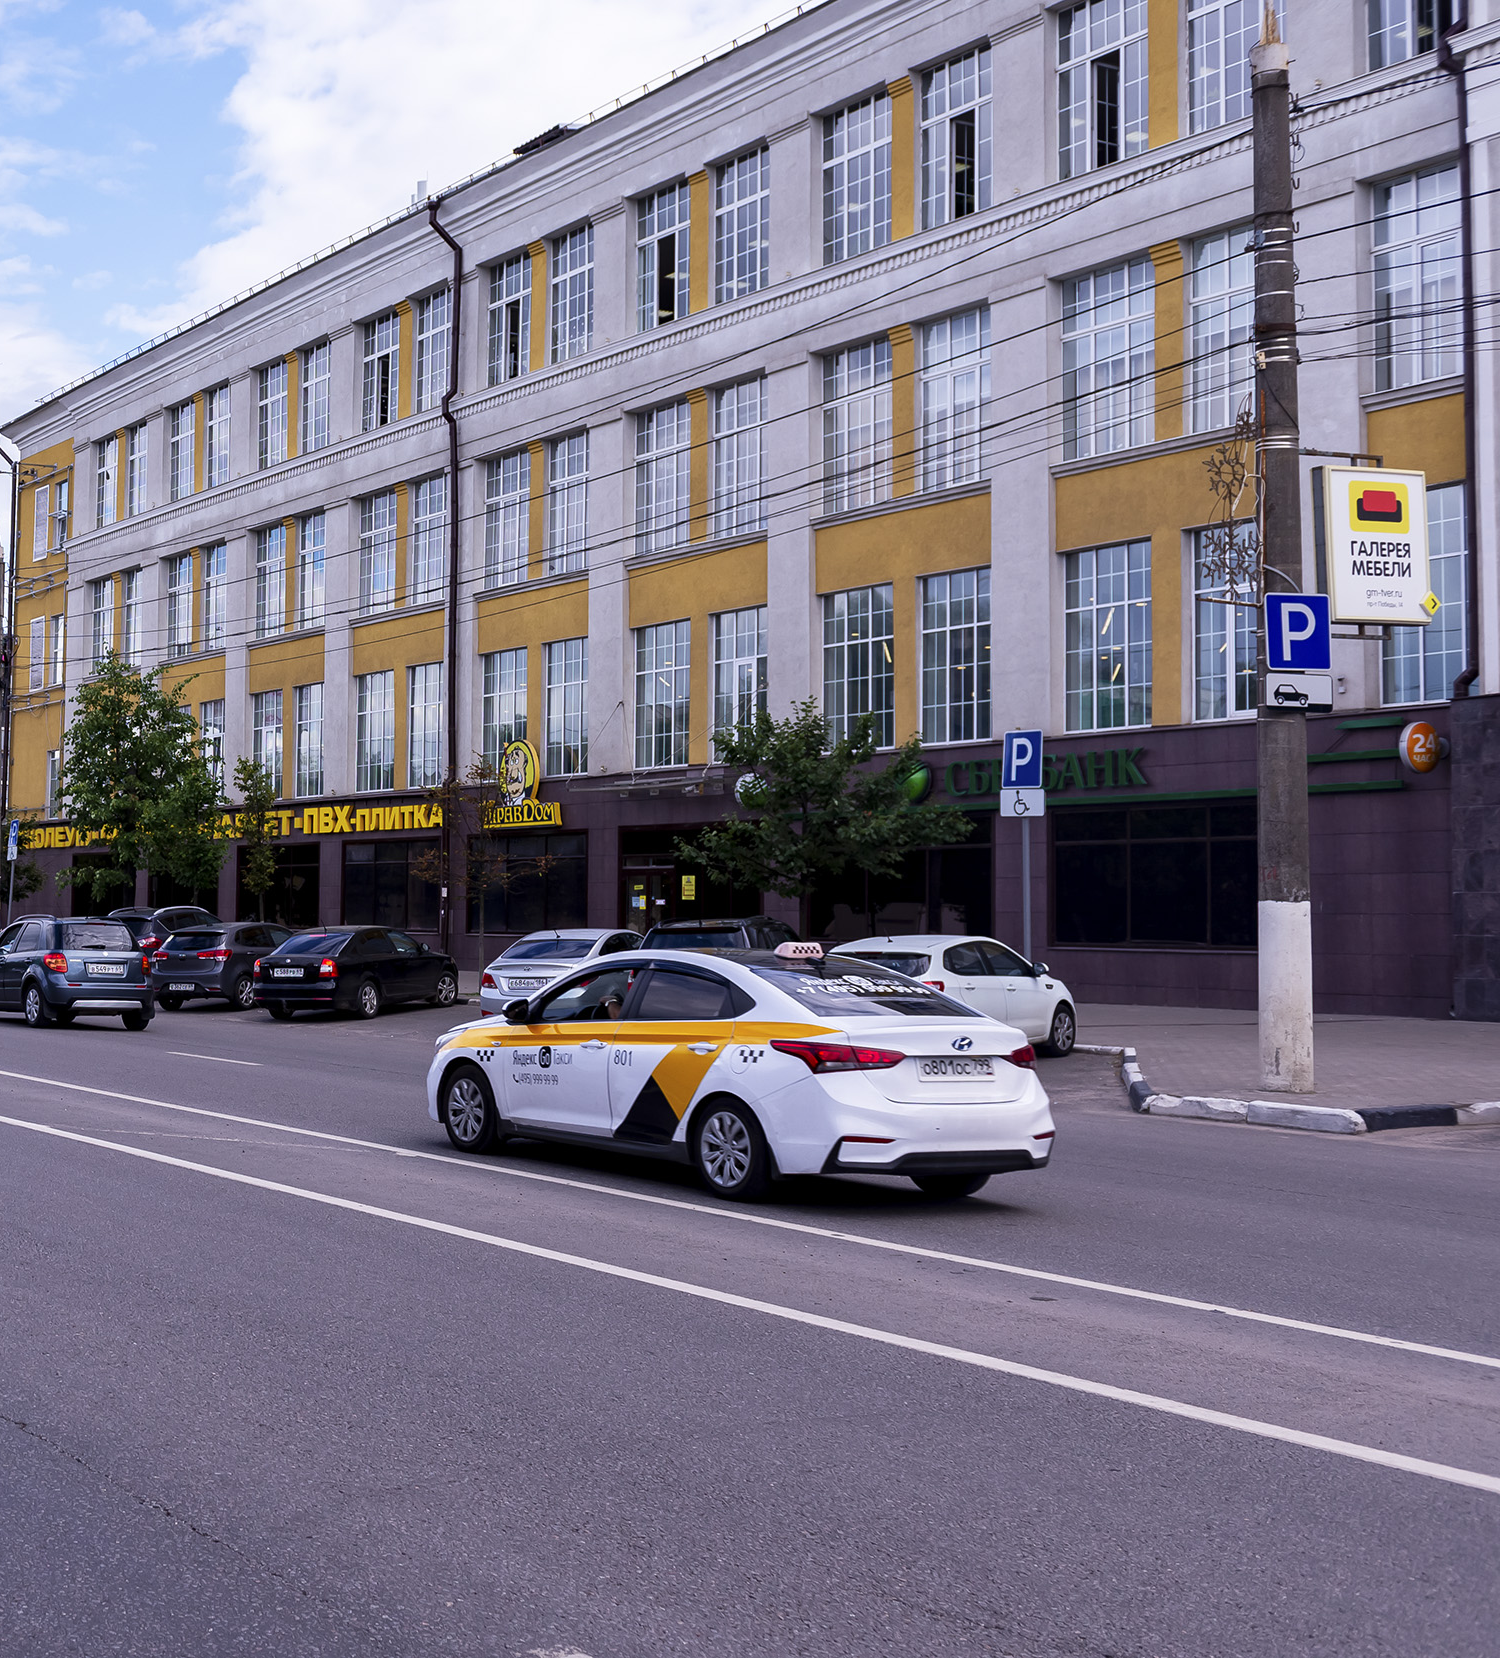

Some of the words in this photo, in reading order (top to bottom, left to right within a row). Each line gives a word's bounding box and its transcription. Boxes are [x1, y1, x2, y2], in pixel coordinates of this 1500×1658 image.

[1350, 540, 1411, 558] ГАЛЕРЕЯ
[1351, 560, 1412, 578] МЕБЕЛИ
[1366, 589, 1403, 599] gm-tver.ru
[1280, 602, 1316, 662] P
[1412, 733, 1436, 752] 24
[1007, 737, 1034, 781] P
[944, 748, 1148, 796] СББАНК
[512, 1050, 537, 1067] Яндекс
[540, 1048, 551, 1066] Go
[553, 1048, 573, 1065] Такси
[613, 1049, 633, 1067] 801
[518, 1072, 533, 1086] (495)
[532, 1073, 543, 1085] 999
[543, 1074, 551, 1085] 99
[551, 1074, 559, 1086] 99
